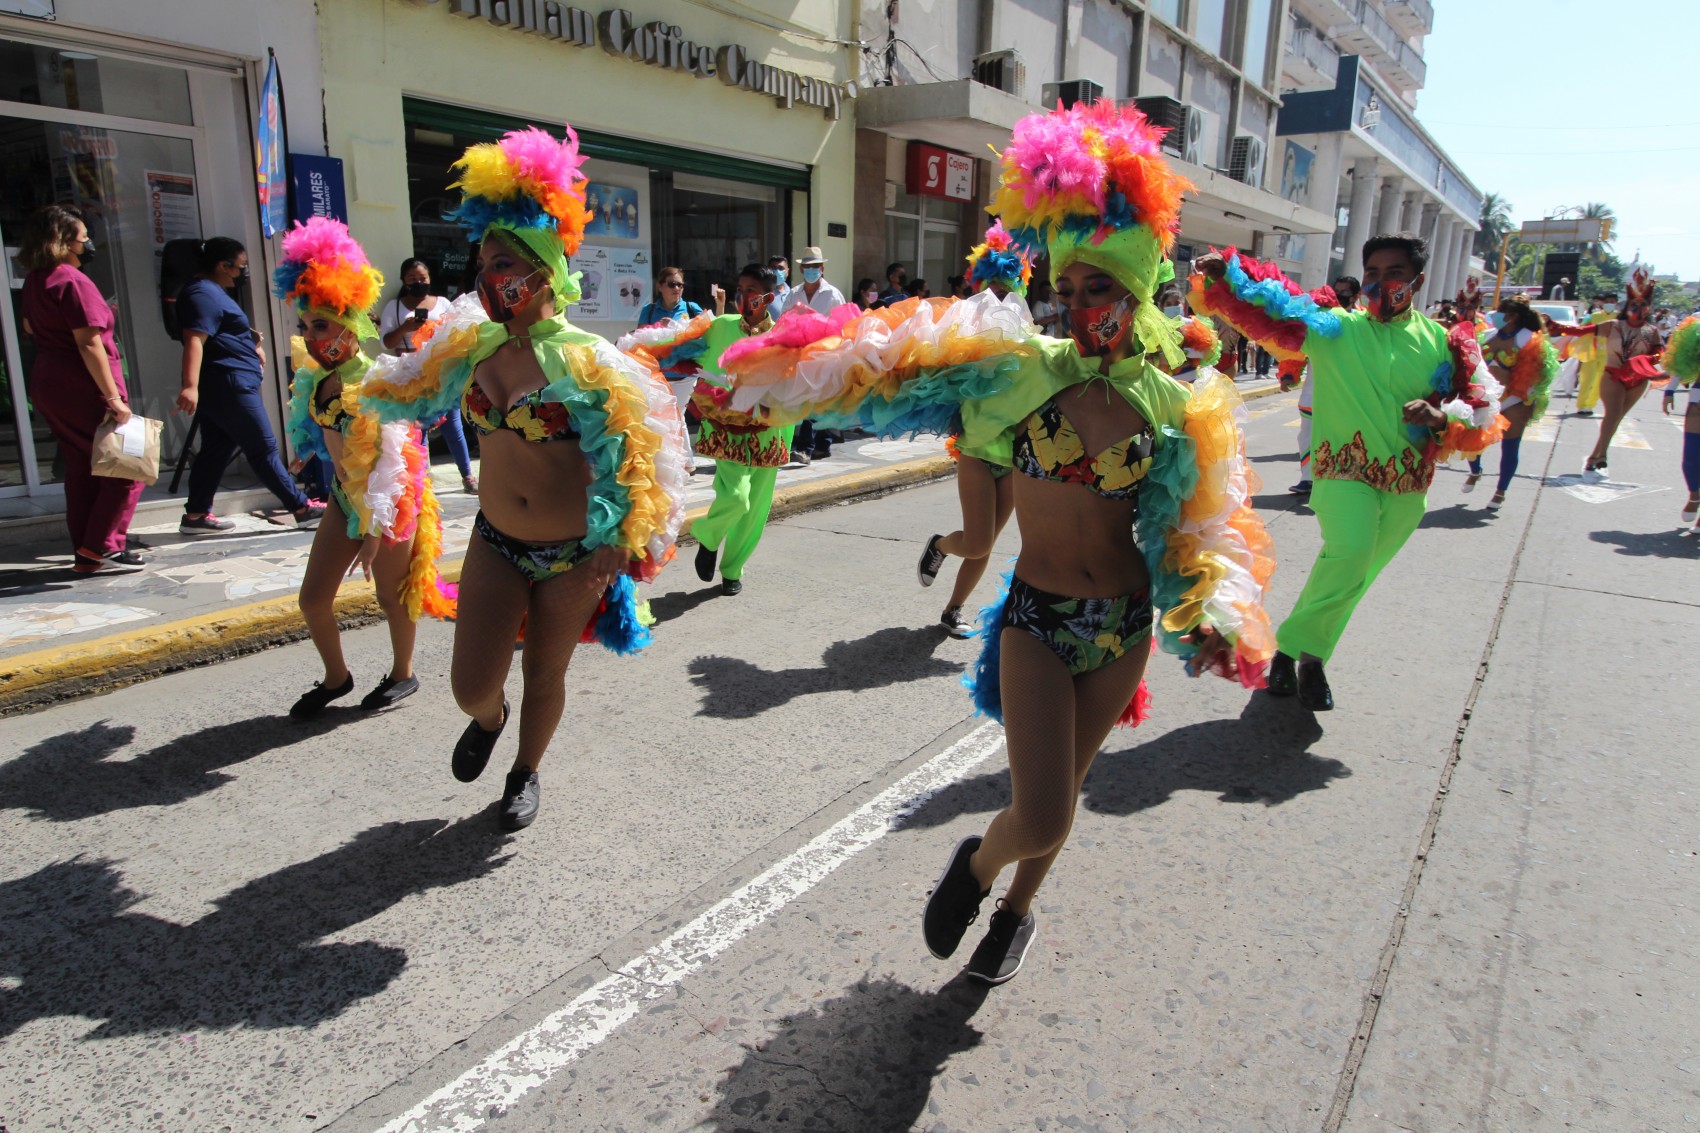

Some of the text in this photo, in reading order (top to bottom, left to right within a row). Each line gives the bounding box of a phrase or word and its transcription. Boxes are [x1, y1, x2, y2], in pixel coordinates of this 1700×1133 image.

[598, 9, 716, 77] Coffee
[716, 44, 858, 120] Company
[949, 156, 968, 171] Cajero
[310, 172, 325, 216] MILARES
[443, 261, 466, 270] Perso
